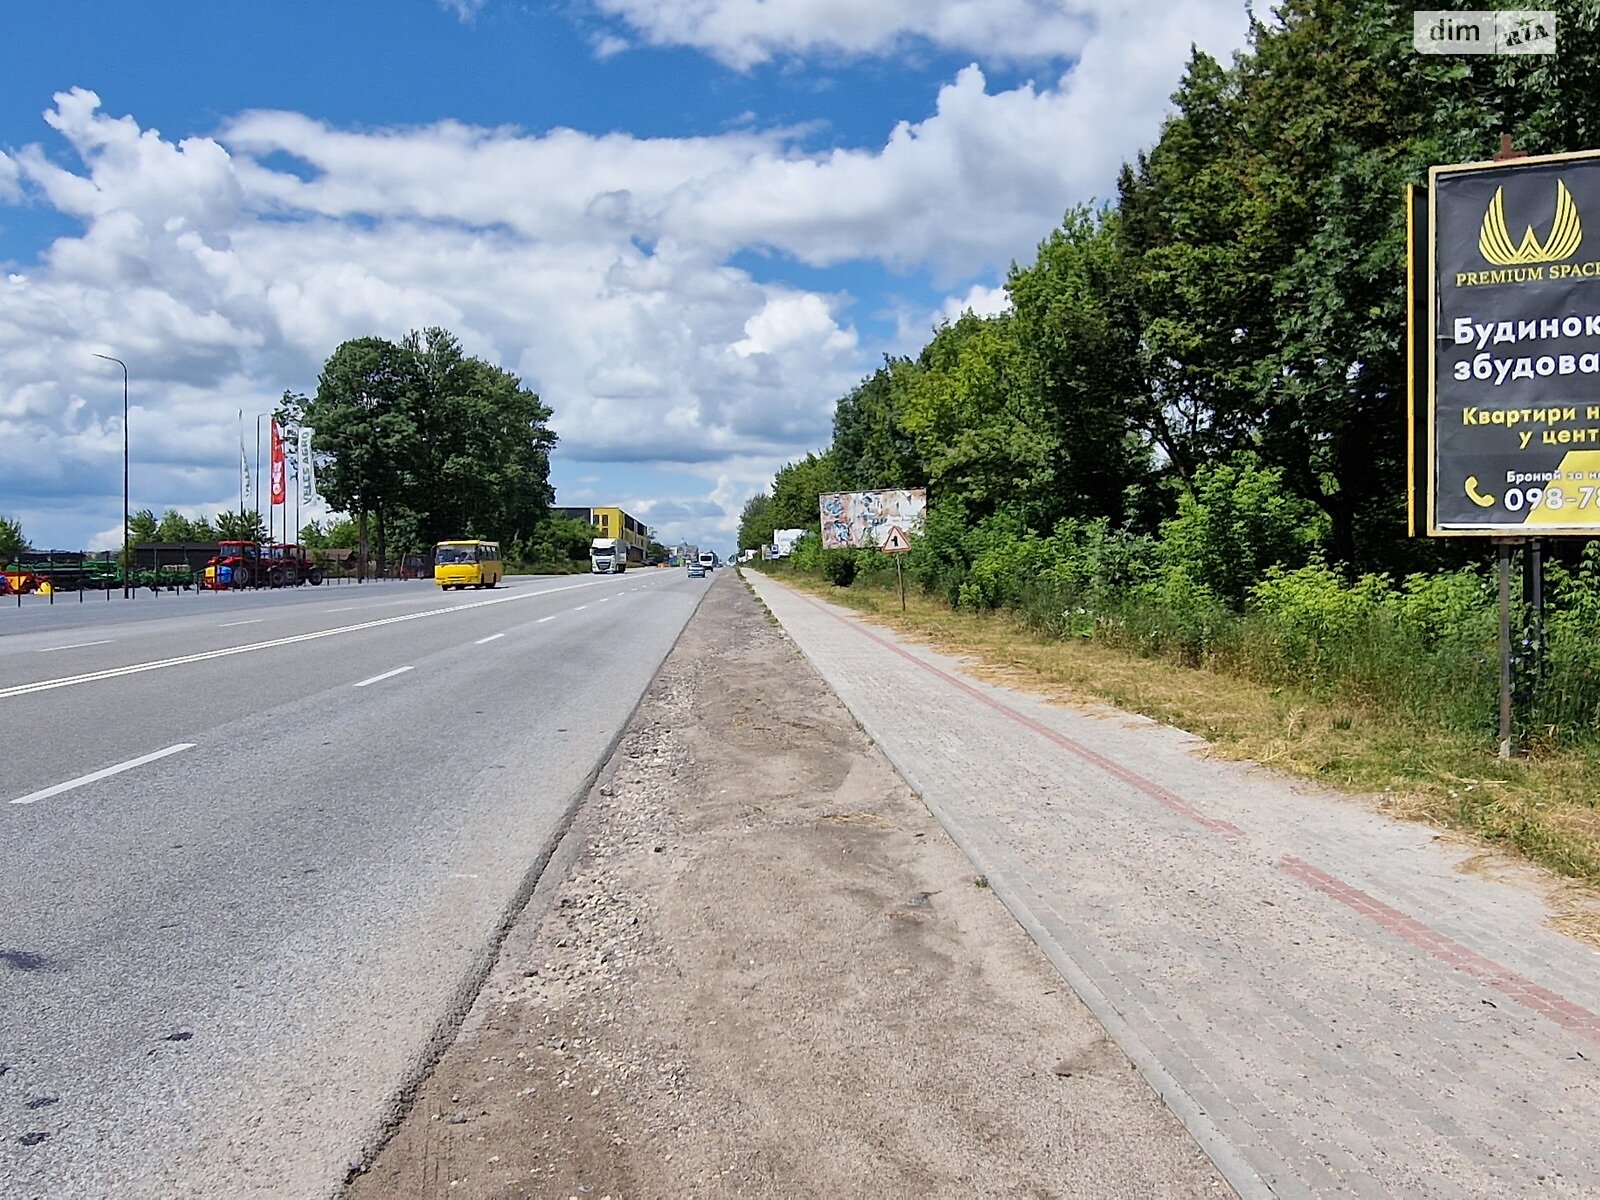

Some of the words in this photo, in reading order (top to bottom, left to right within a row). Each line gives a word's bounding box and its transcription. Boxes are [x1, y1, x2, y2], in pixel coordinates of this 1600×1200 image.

[1456, 267, 1544, 287] PREMIUM
[1454, 315, 1600, 350] Будинок
[1463, 406, 1576, 428] Квартири
[1519, 431, 1533, 449] у
[1506, 469, 1561, 485] Бронюй
